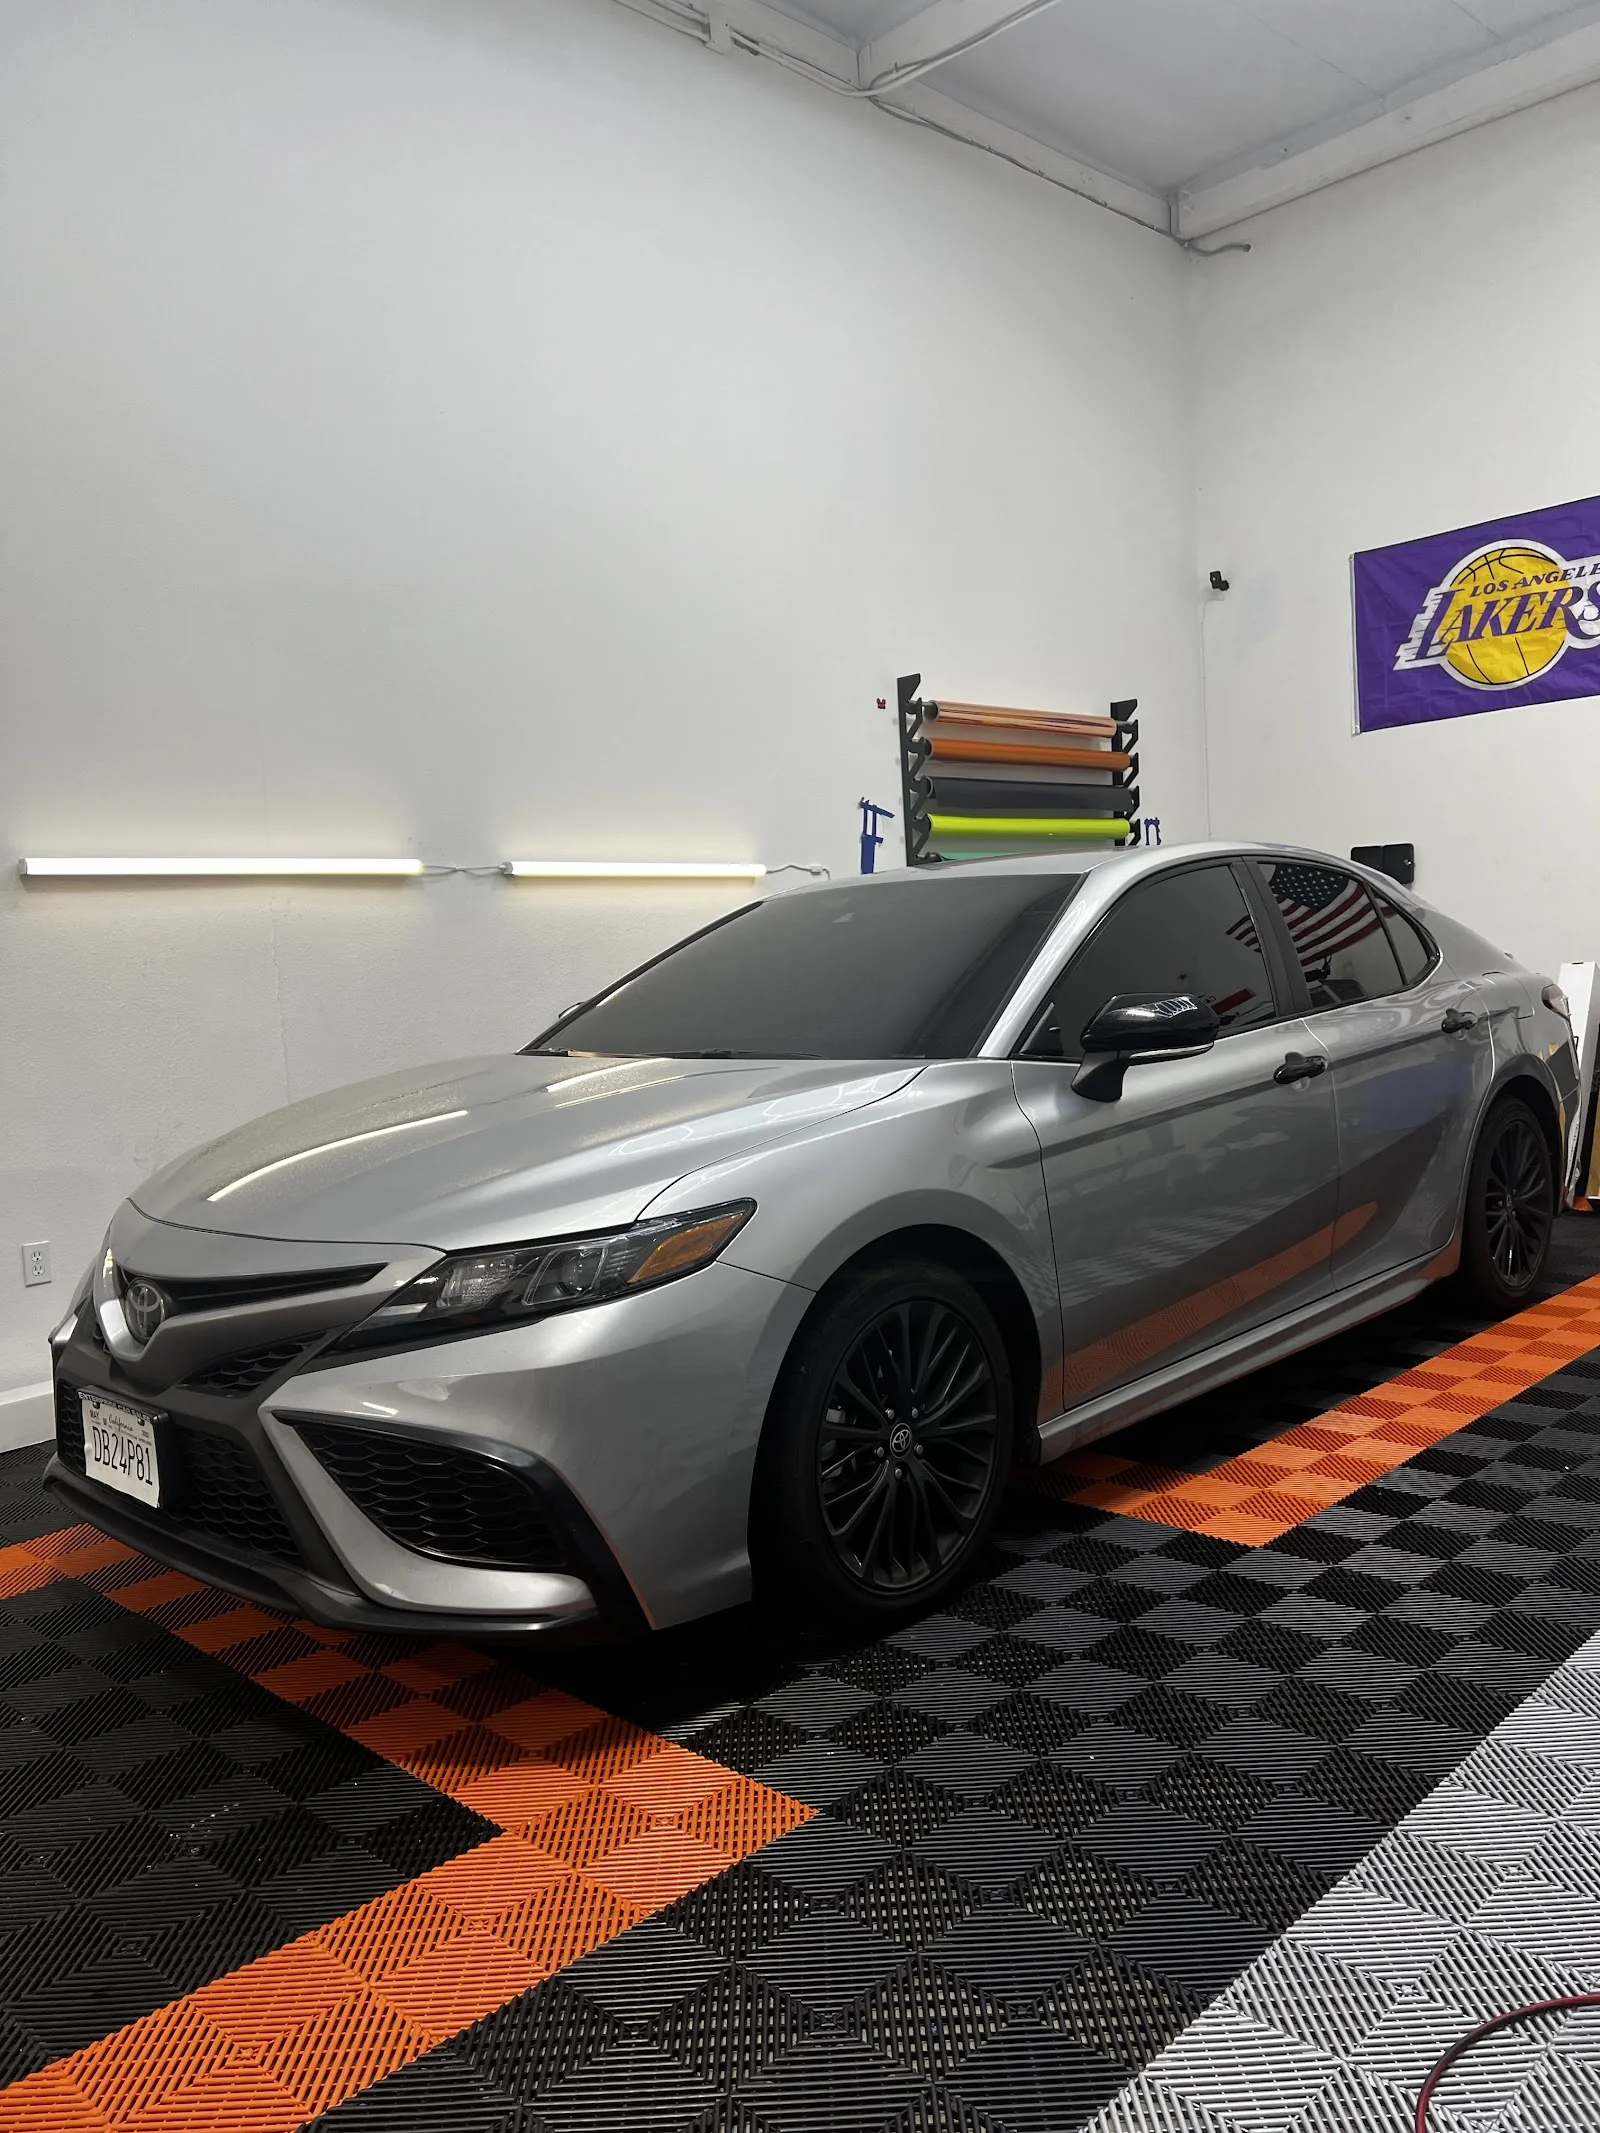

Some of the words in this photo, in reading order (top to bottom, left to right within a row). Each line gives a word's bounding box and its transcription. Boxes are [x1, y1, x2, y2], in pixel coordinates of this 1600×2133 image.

[1469, 580, 1509, 598] LOS
[1511, 562, 1600, 590] ANGELE
[90, 1409, 99, 1418] MAY
[108, 1413, 134, 1432] California
[92, 1426, 153, 1486] DB24P81
